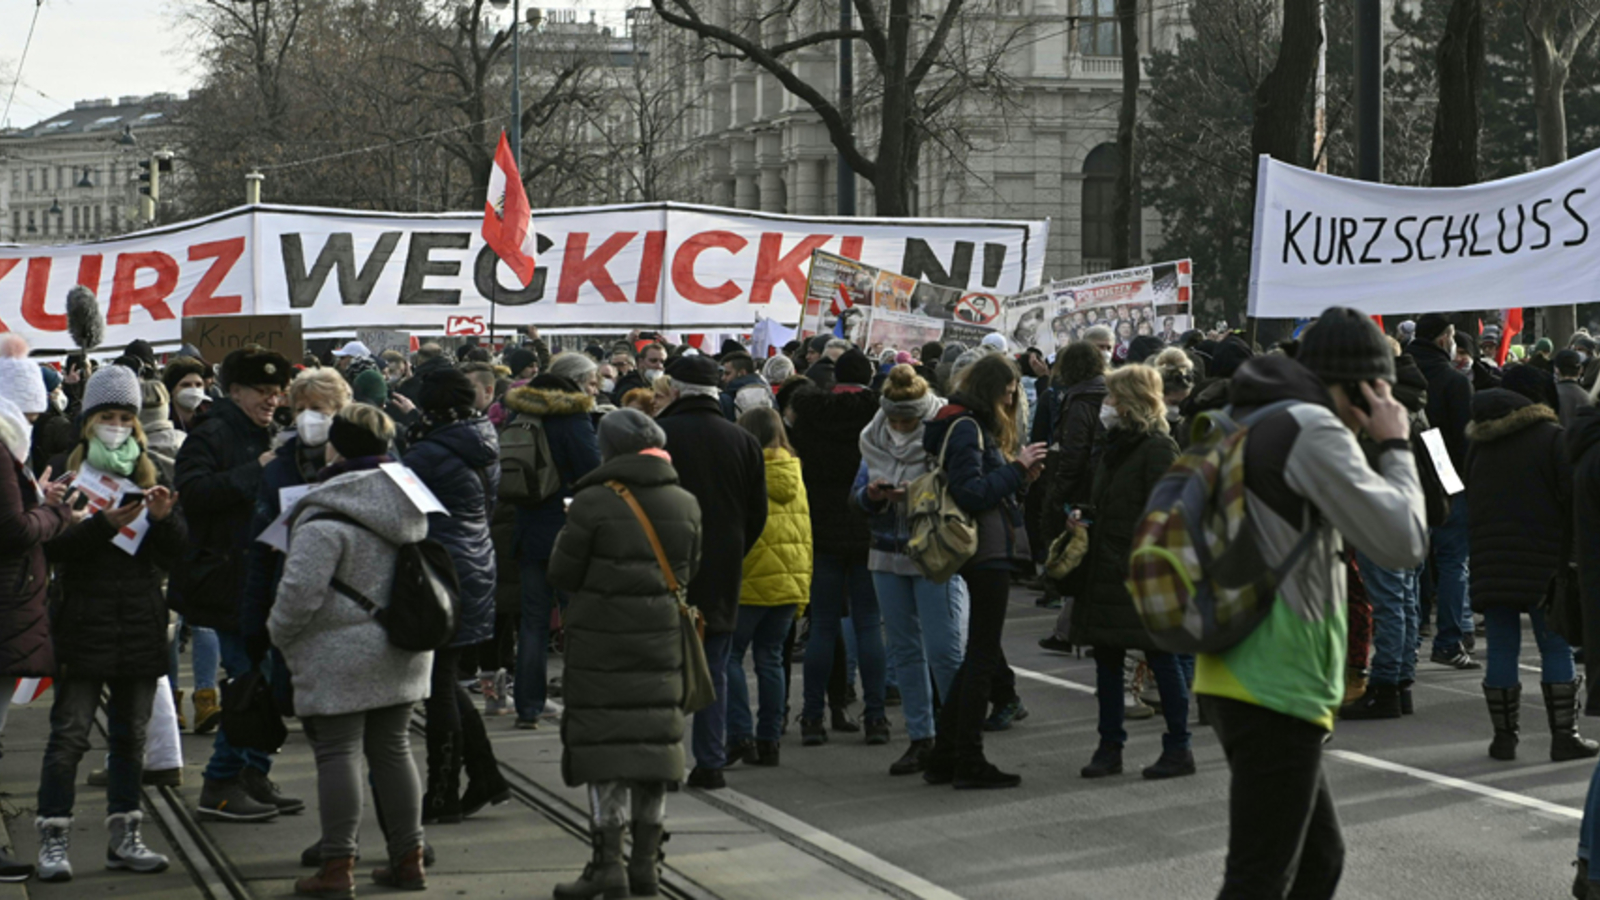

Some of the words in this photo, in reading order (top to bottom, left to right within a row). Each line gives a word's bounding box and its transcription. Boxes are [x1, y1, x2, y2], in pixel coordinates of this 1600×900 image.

[1283, 188, 1589, 265] KURZSCHLUSS
[0, 237, 246, 333] URZ
[200, 322, 283, 348] Kinder
